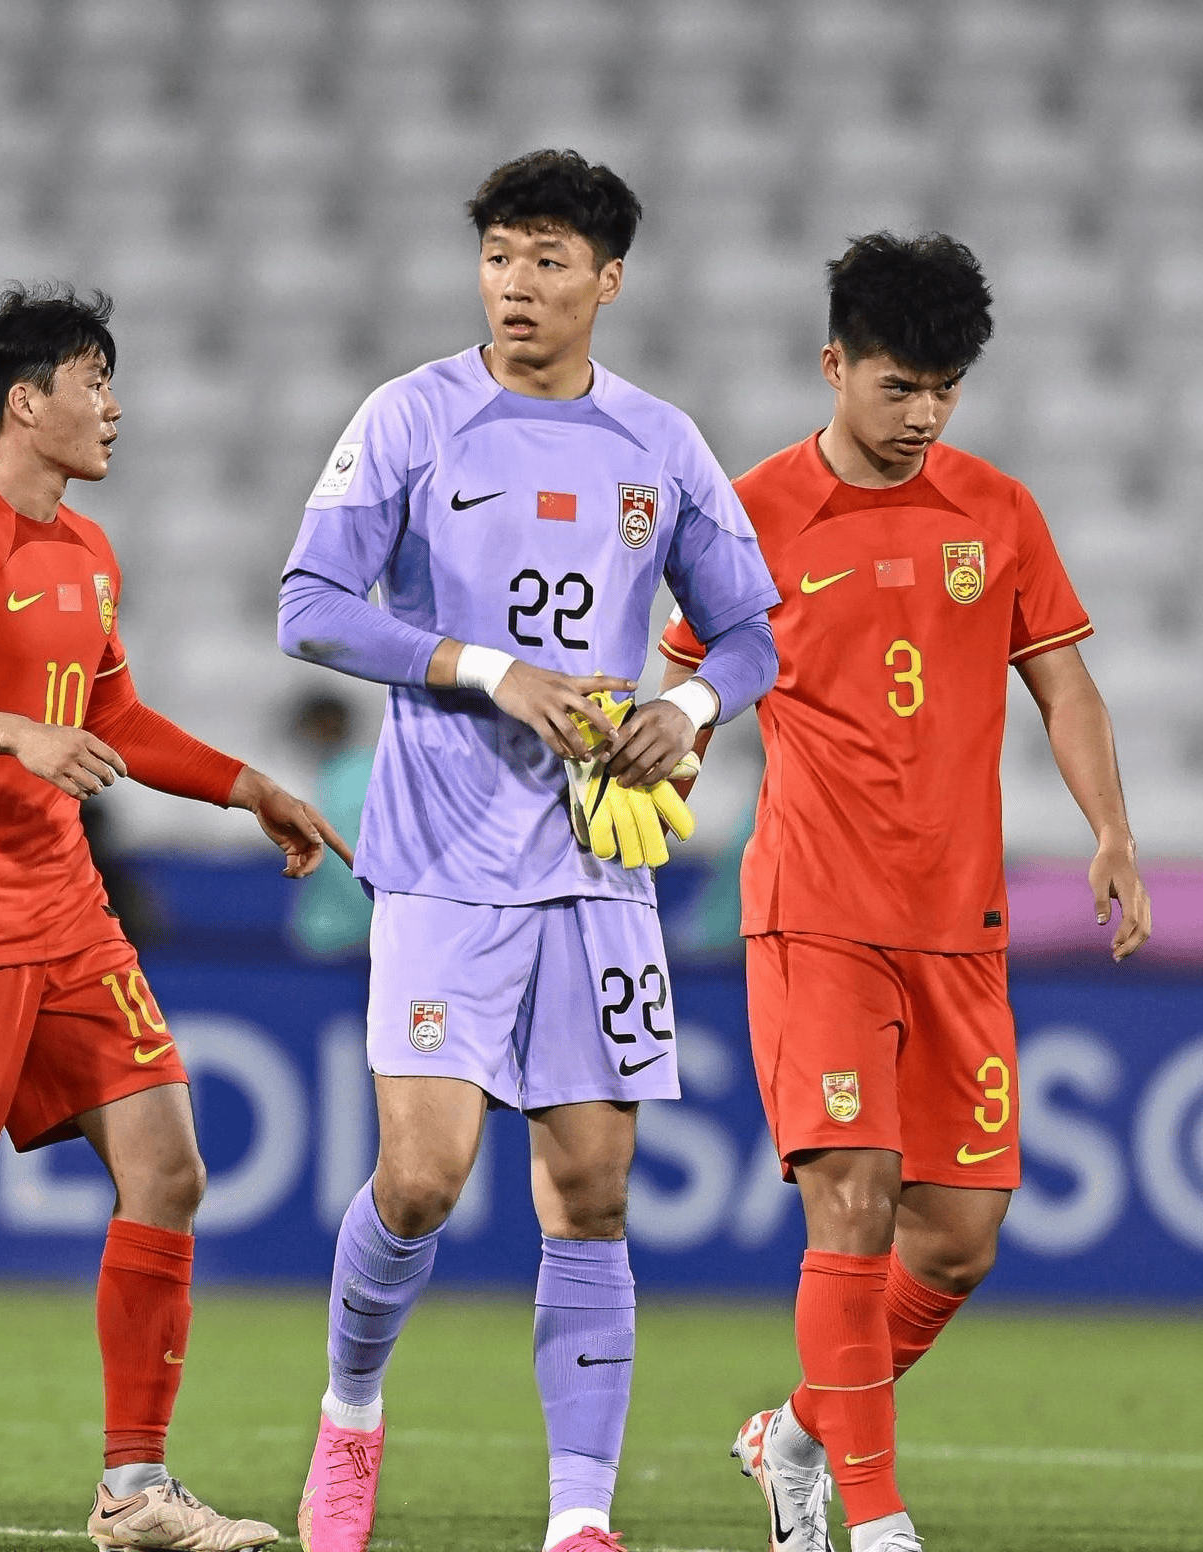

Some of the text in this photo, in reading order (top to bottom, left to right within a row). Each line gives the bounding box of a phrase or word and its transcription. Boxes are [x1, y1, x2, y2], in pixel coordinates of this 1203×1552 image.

[623, 489, 654, 504] CFA
[946, 546, 980, 558] CFA
[507, 569, 594, 650] 22
[45, 661, 86, 729] 10
[884, 639, 924, 718] 3
[101, 968, 167, 1038] 10
[414, 1005, 443, 1015] CFA
[601, 964, 673, 1044] 22
[974, 1056, 1010, 1133] 3
